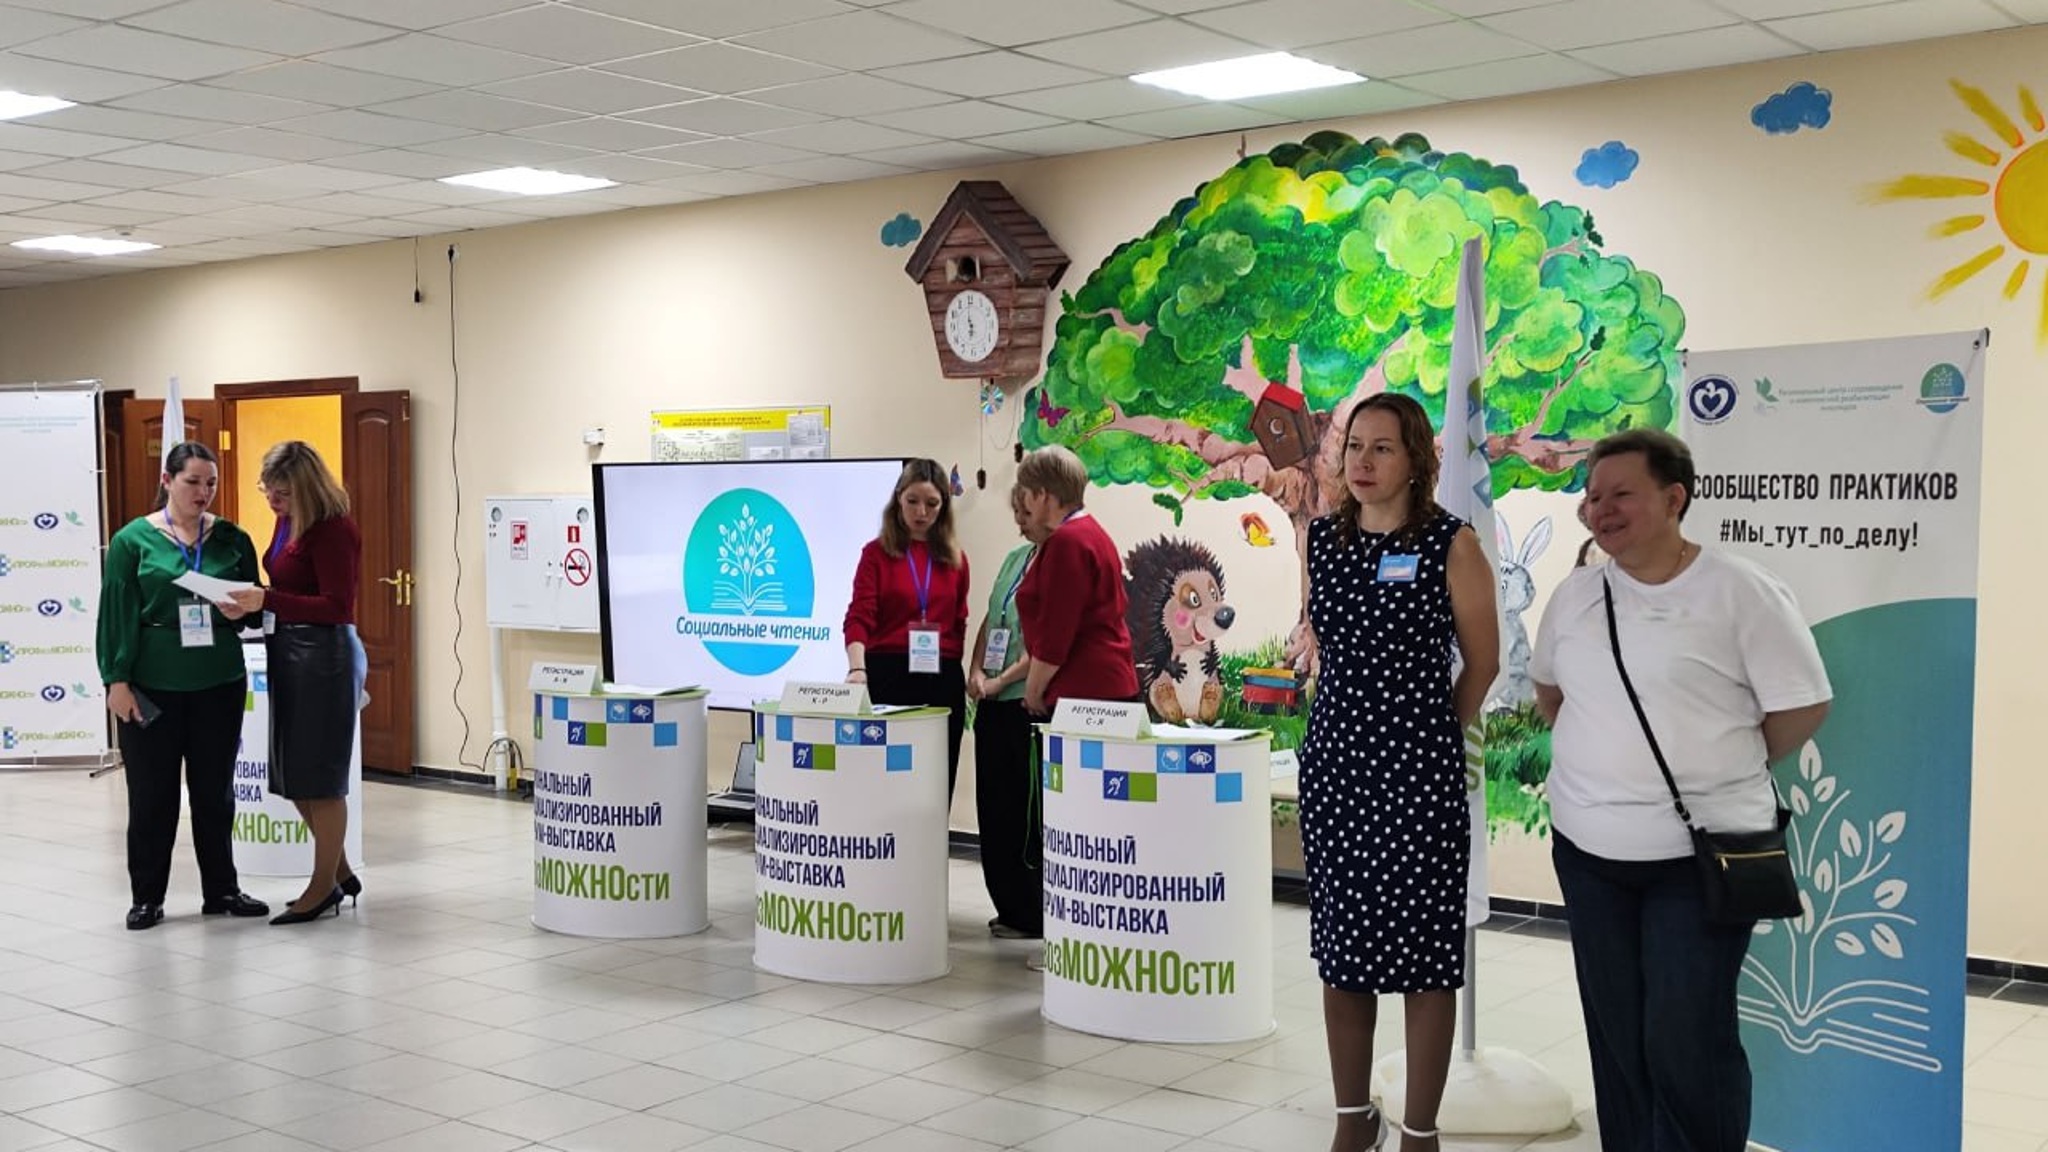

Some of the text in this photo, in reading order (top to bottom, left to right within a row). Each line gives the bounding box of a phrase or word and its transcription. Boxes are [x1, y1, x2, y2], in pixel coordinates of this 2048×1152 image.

[1692, 472, 1958, 502] СООБЩЕСТВО ПРАКТИКОВ
[1719, 518, 1919, 552] #Мы_тут_по_делу!
[676, 616, 830, 641] Социальные чтения
